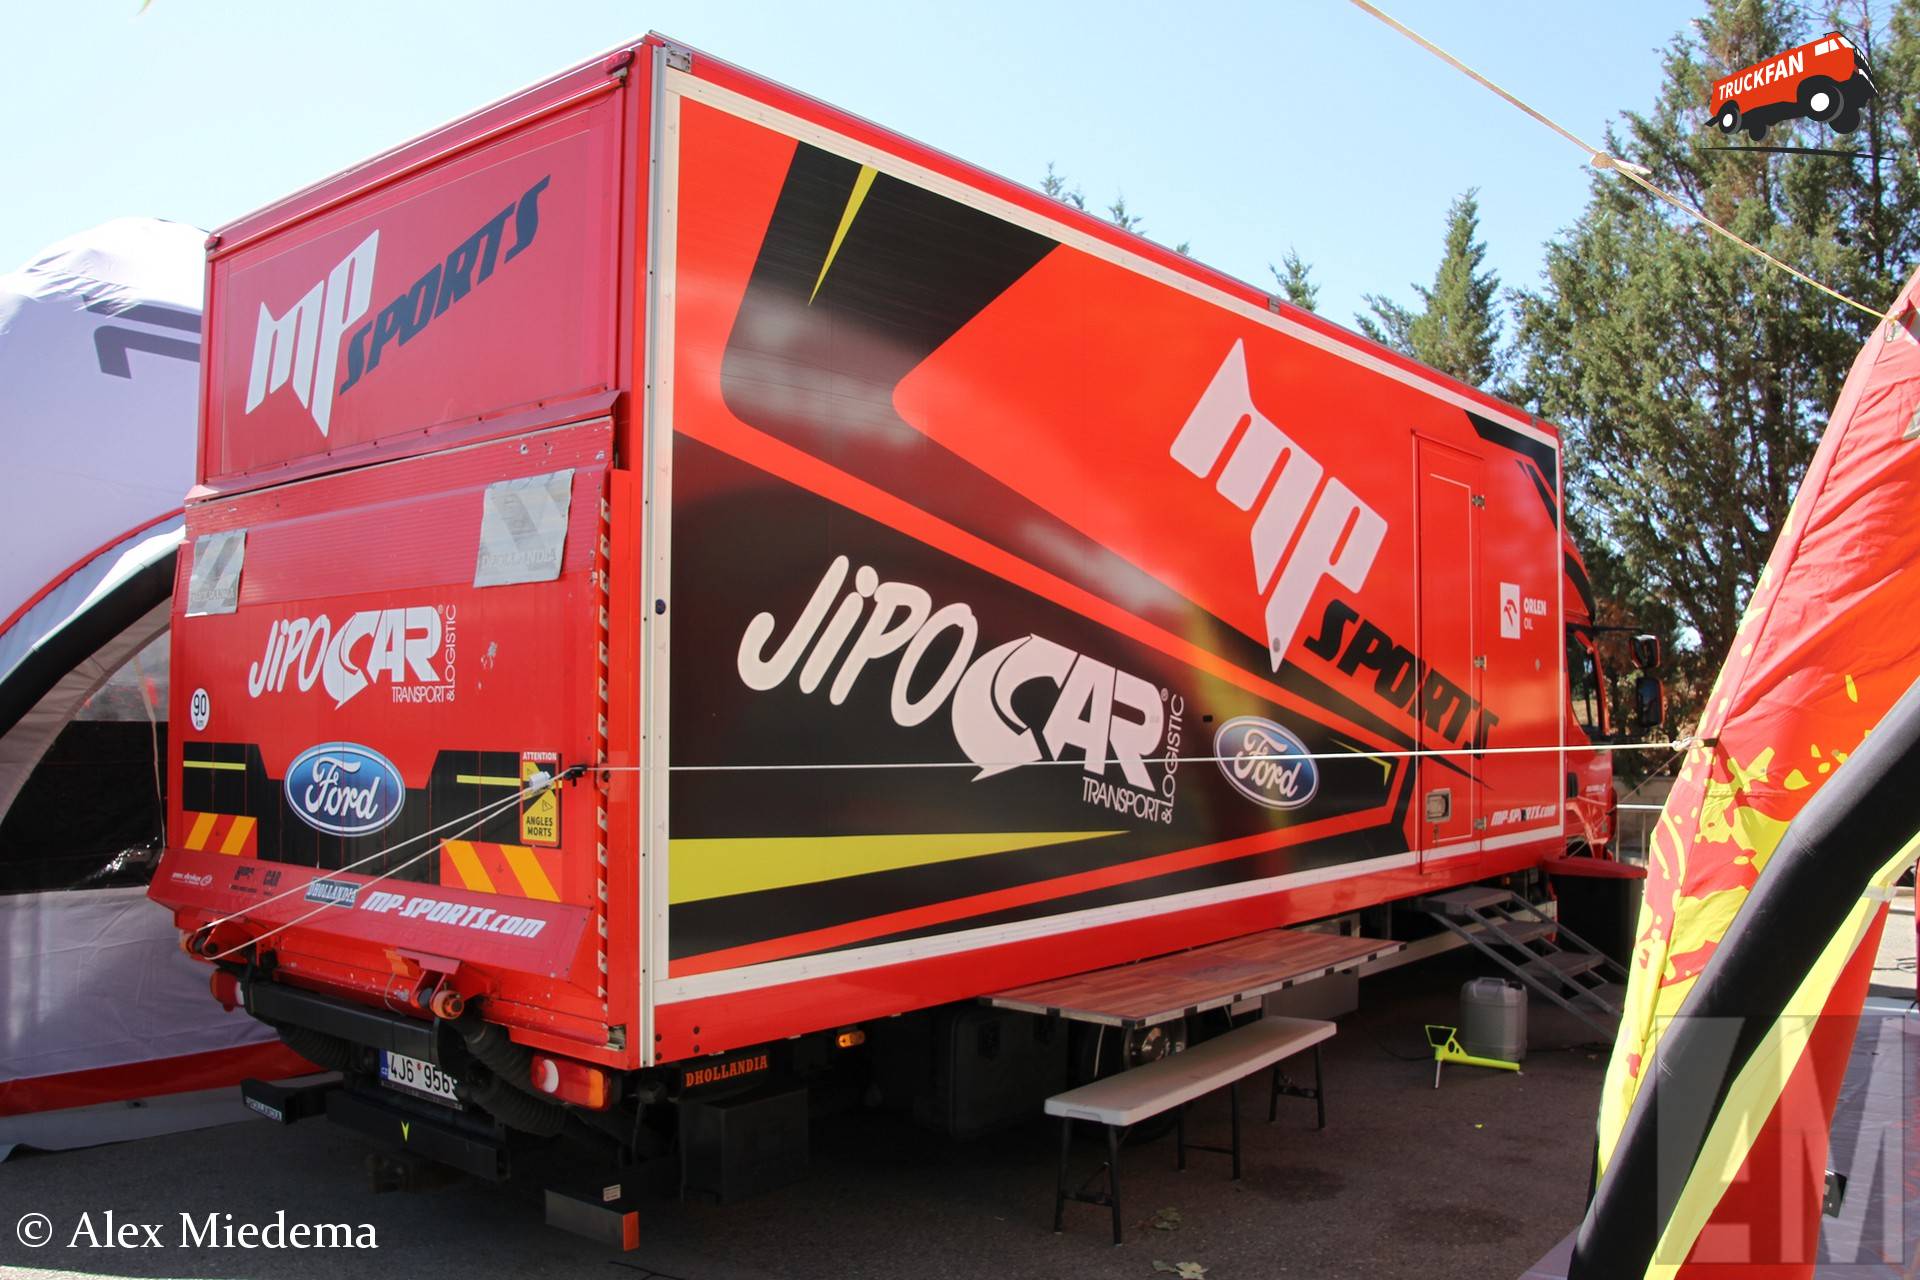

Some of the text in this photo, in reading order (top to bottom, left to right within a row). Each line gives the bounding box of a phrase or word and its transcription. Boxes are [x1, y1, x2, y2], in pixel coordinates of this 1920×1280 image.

[245, 174, 551, 437] MP SPORTS
[1169, 338, 1499, 758] MP SPORTS
[1523, 597, 1547, 616] ORLEN
[1523, 617, 1534, 630] OIL
[193, 694, 207, 717] 90
[391, 686, 446, 703] TRANSPORT
[523, 752, 557, 761] ATTENTION
[1234, 729, 1302, 798] Ford
[305, 757, 380, 820] Ford
[1082, 776, 1161, 823] TRANSPORT
[526, 816, 553, 827] ANGLES
[527, 826, 552, 837] MORTS
[685, 1055, 768, 1088] DHOLLANDIA
